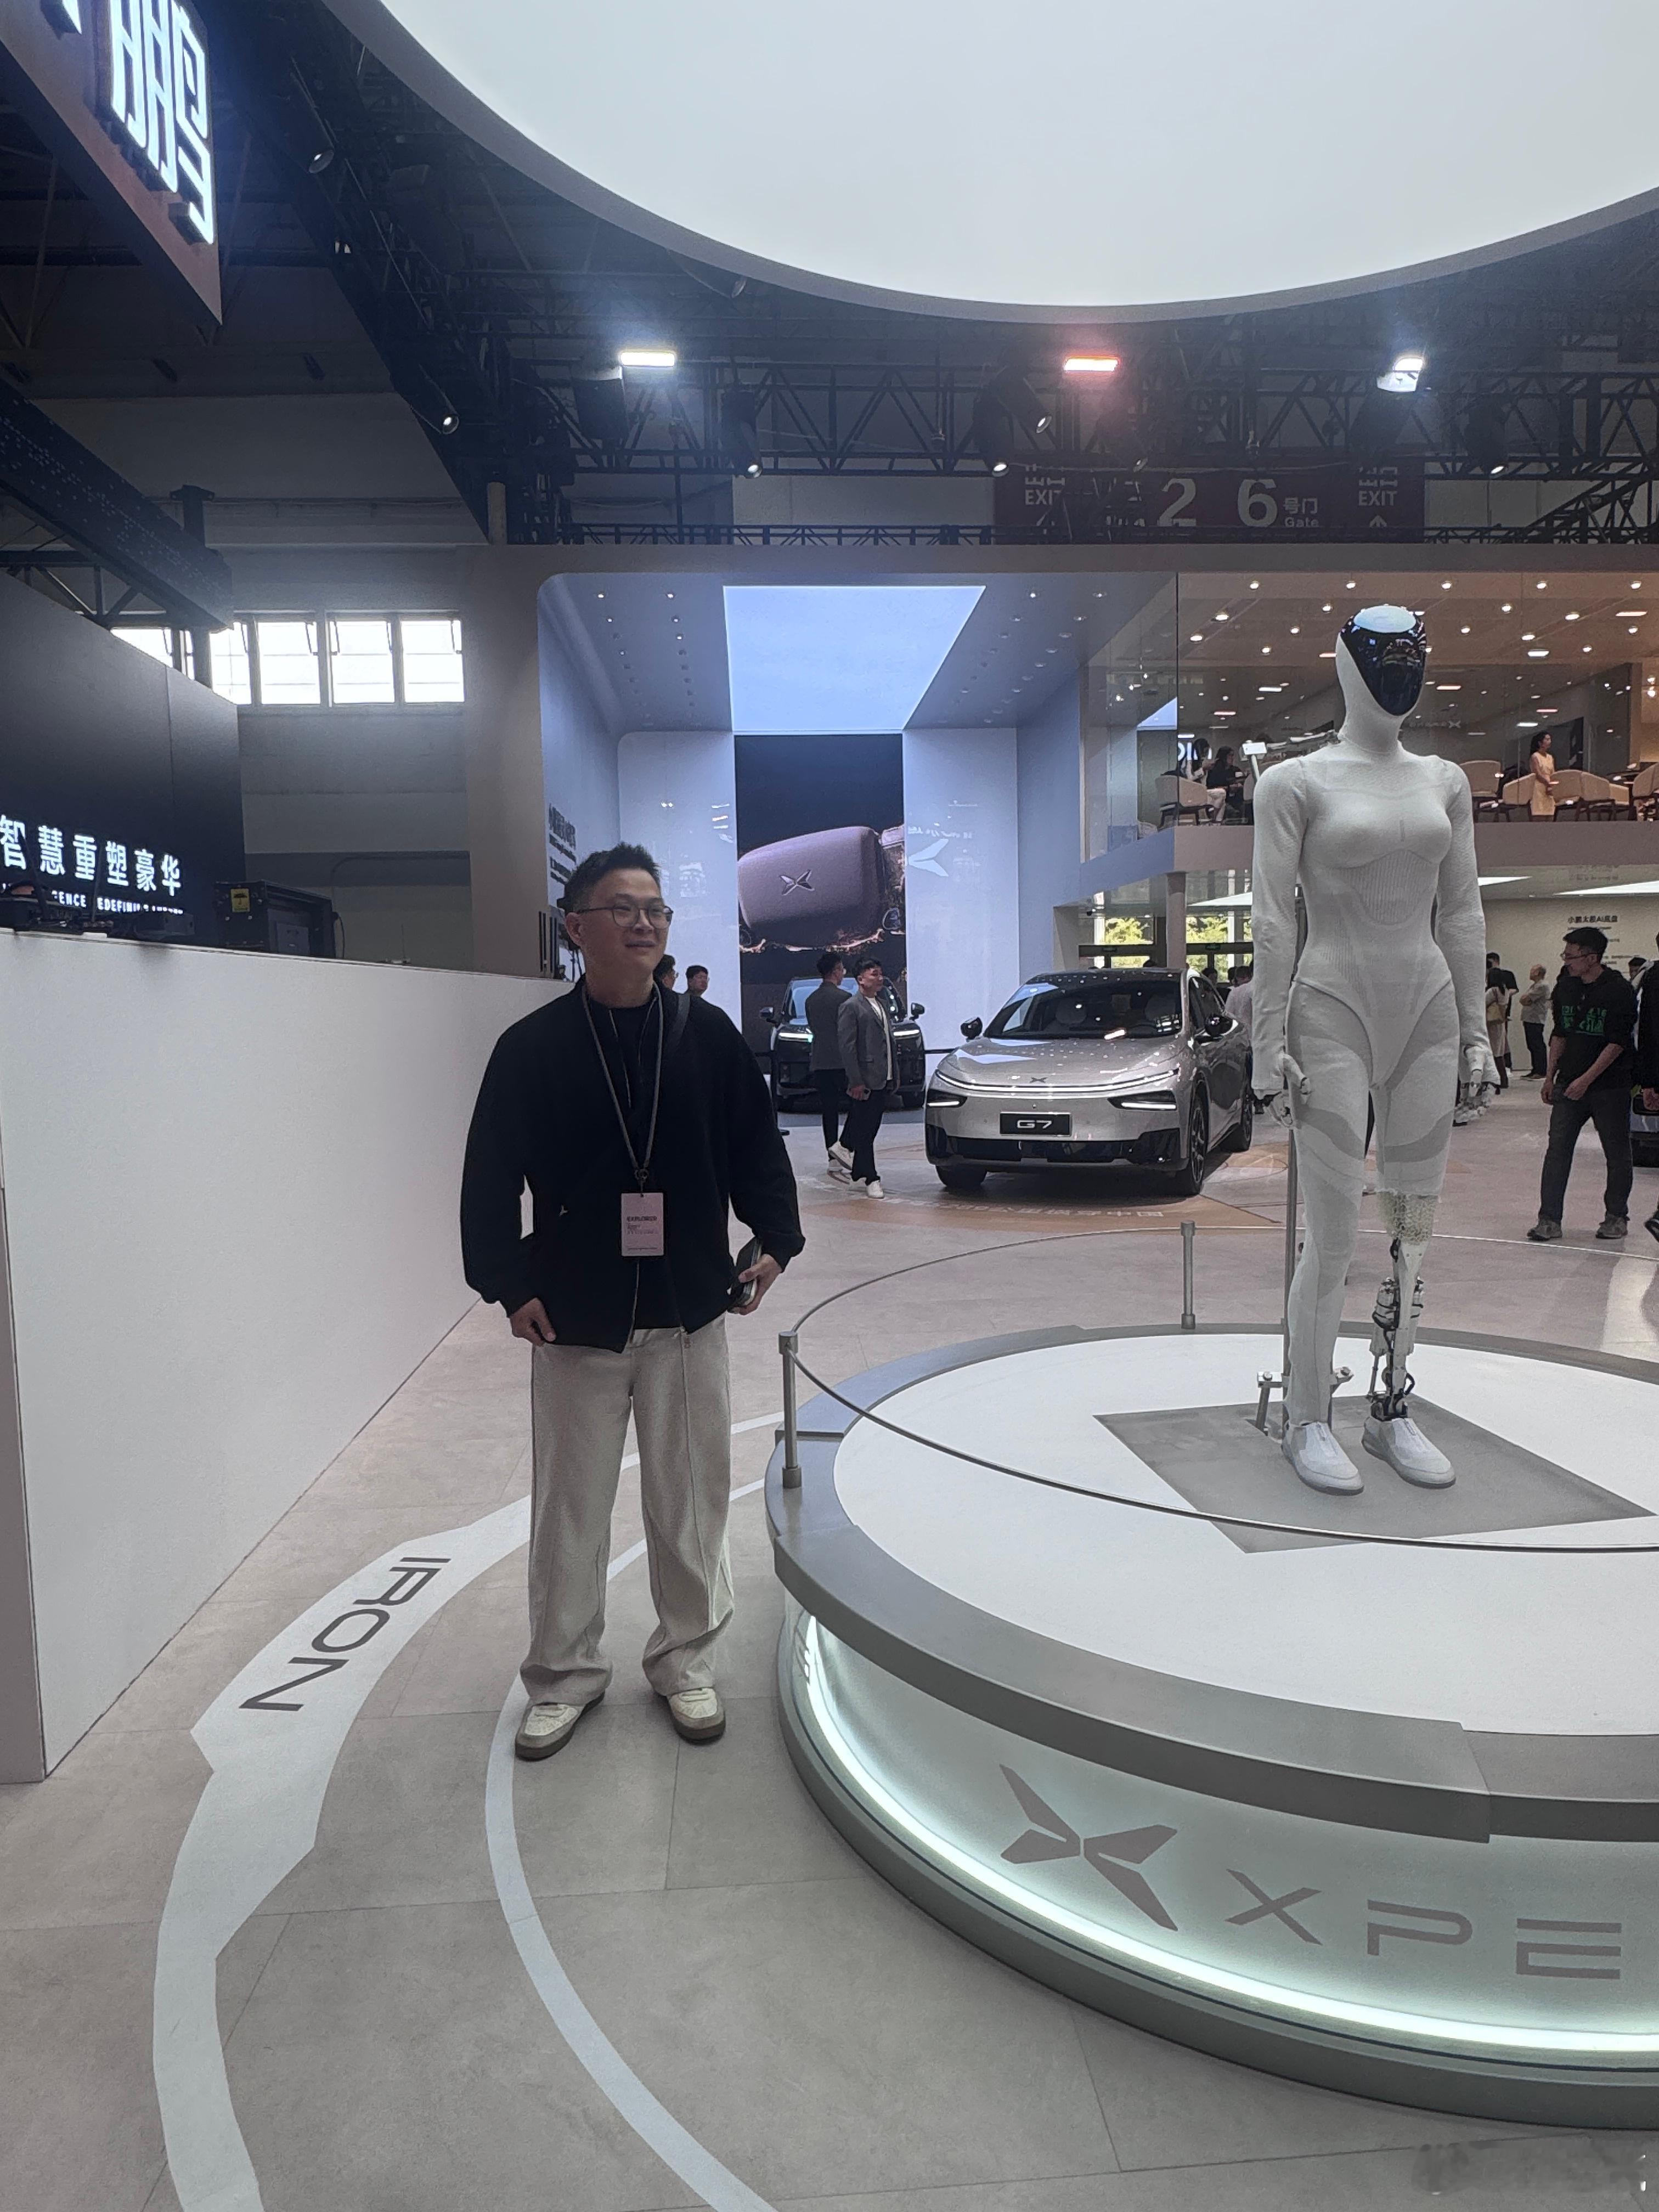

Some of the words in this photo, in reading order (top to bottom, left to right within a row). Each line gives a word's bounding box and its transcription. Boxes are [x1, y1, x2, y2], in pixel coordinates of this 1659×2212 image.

[64, 0, 214, 245] 鹏
[1157, 478, 1196, 526] 2
[1237, 478, 1278, 527] 6
[1284, 516, 1319, 528] Gate
[1358, 490, 1398, 506] EXIT
[0, 814, 182, 896] 智慧重塑豪华
[1017, 1120, 1052, 1128] G7
[239, 1557, 452, 1712] IRON
[1225, 1868, 1622, 1980] XPE
